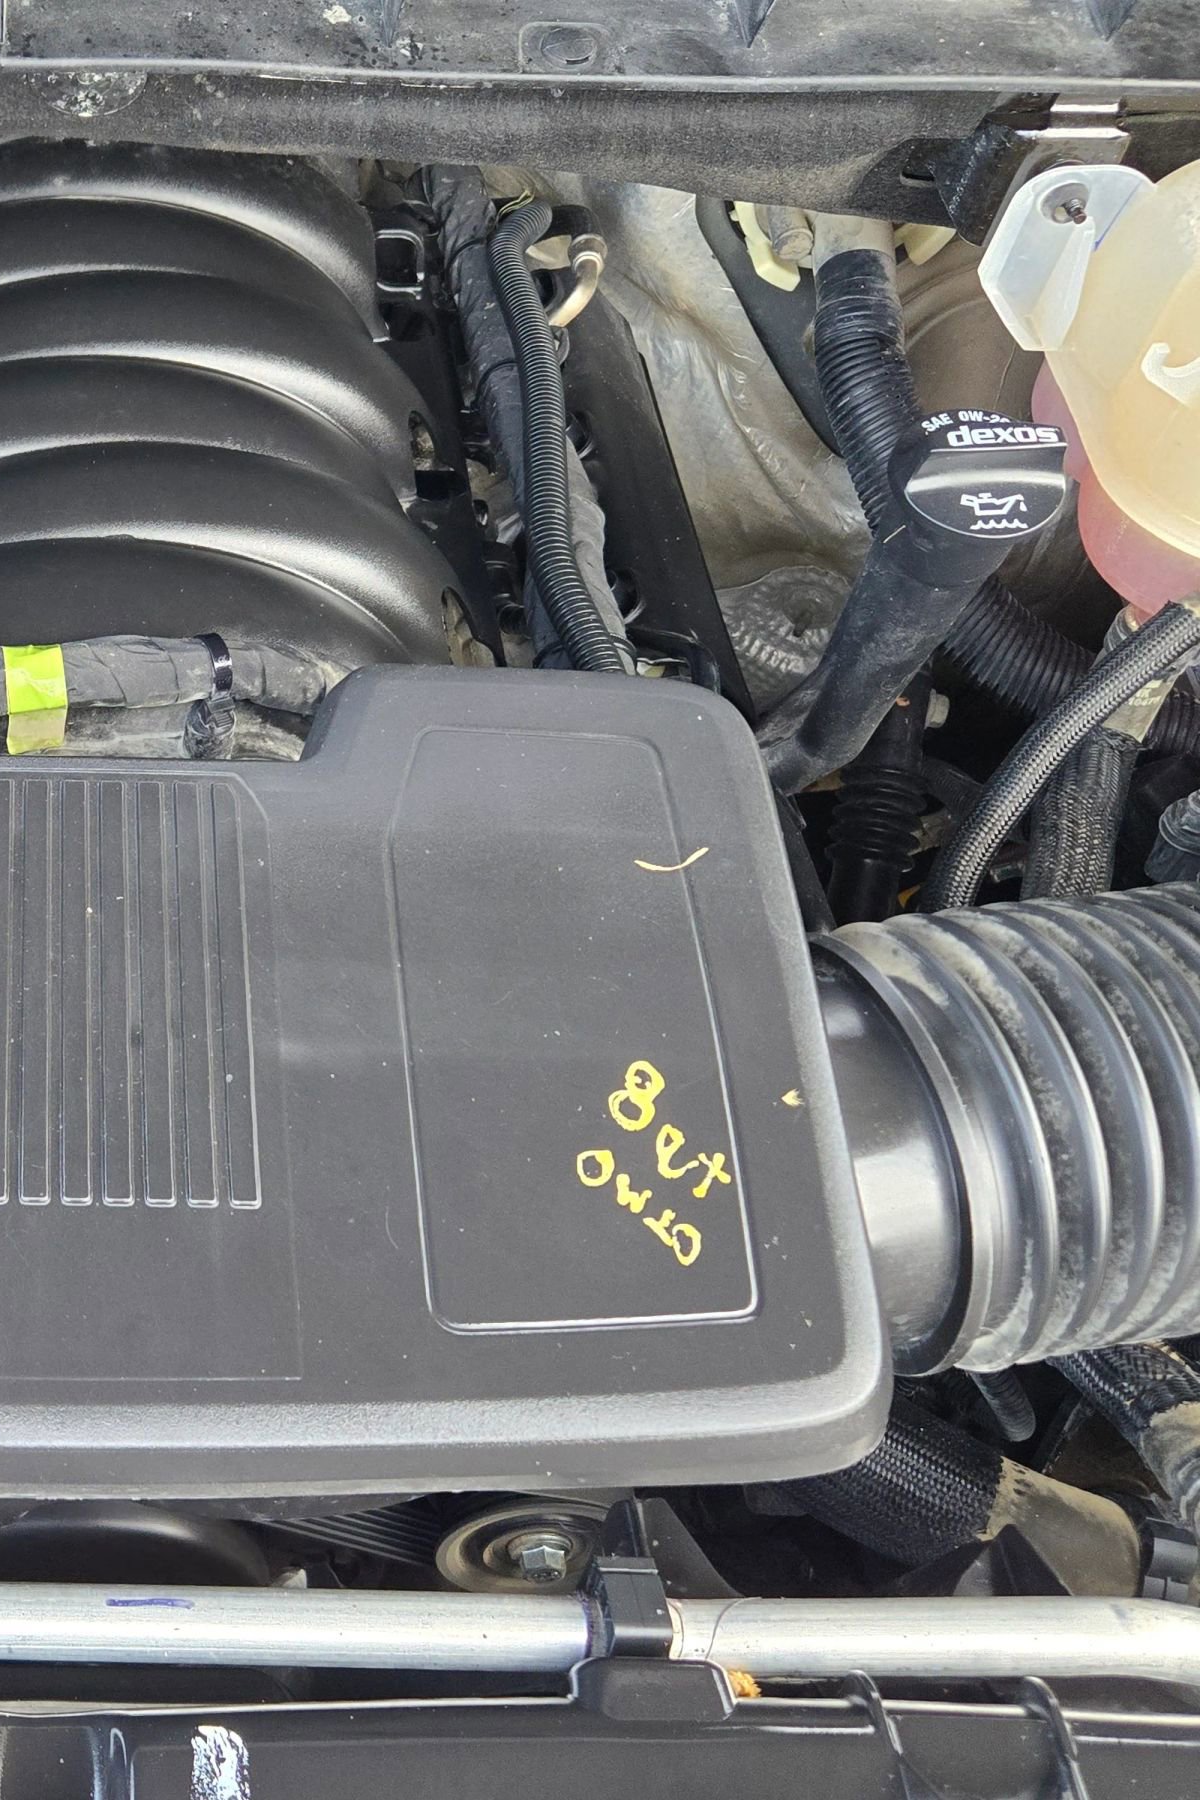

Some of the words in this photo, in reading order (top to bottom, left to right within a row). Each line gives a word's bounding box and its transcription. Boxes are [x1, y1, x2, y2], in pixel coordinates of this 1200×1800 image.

[921, 413, 954, 432] SAE
[947, 425, 1059, 447] dexos
[608, 1060, 666, 1132] 8
